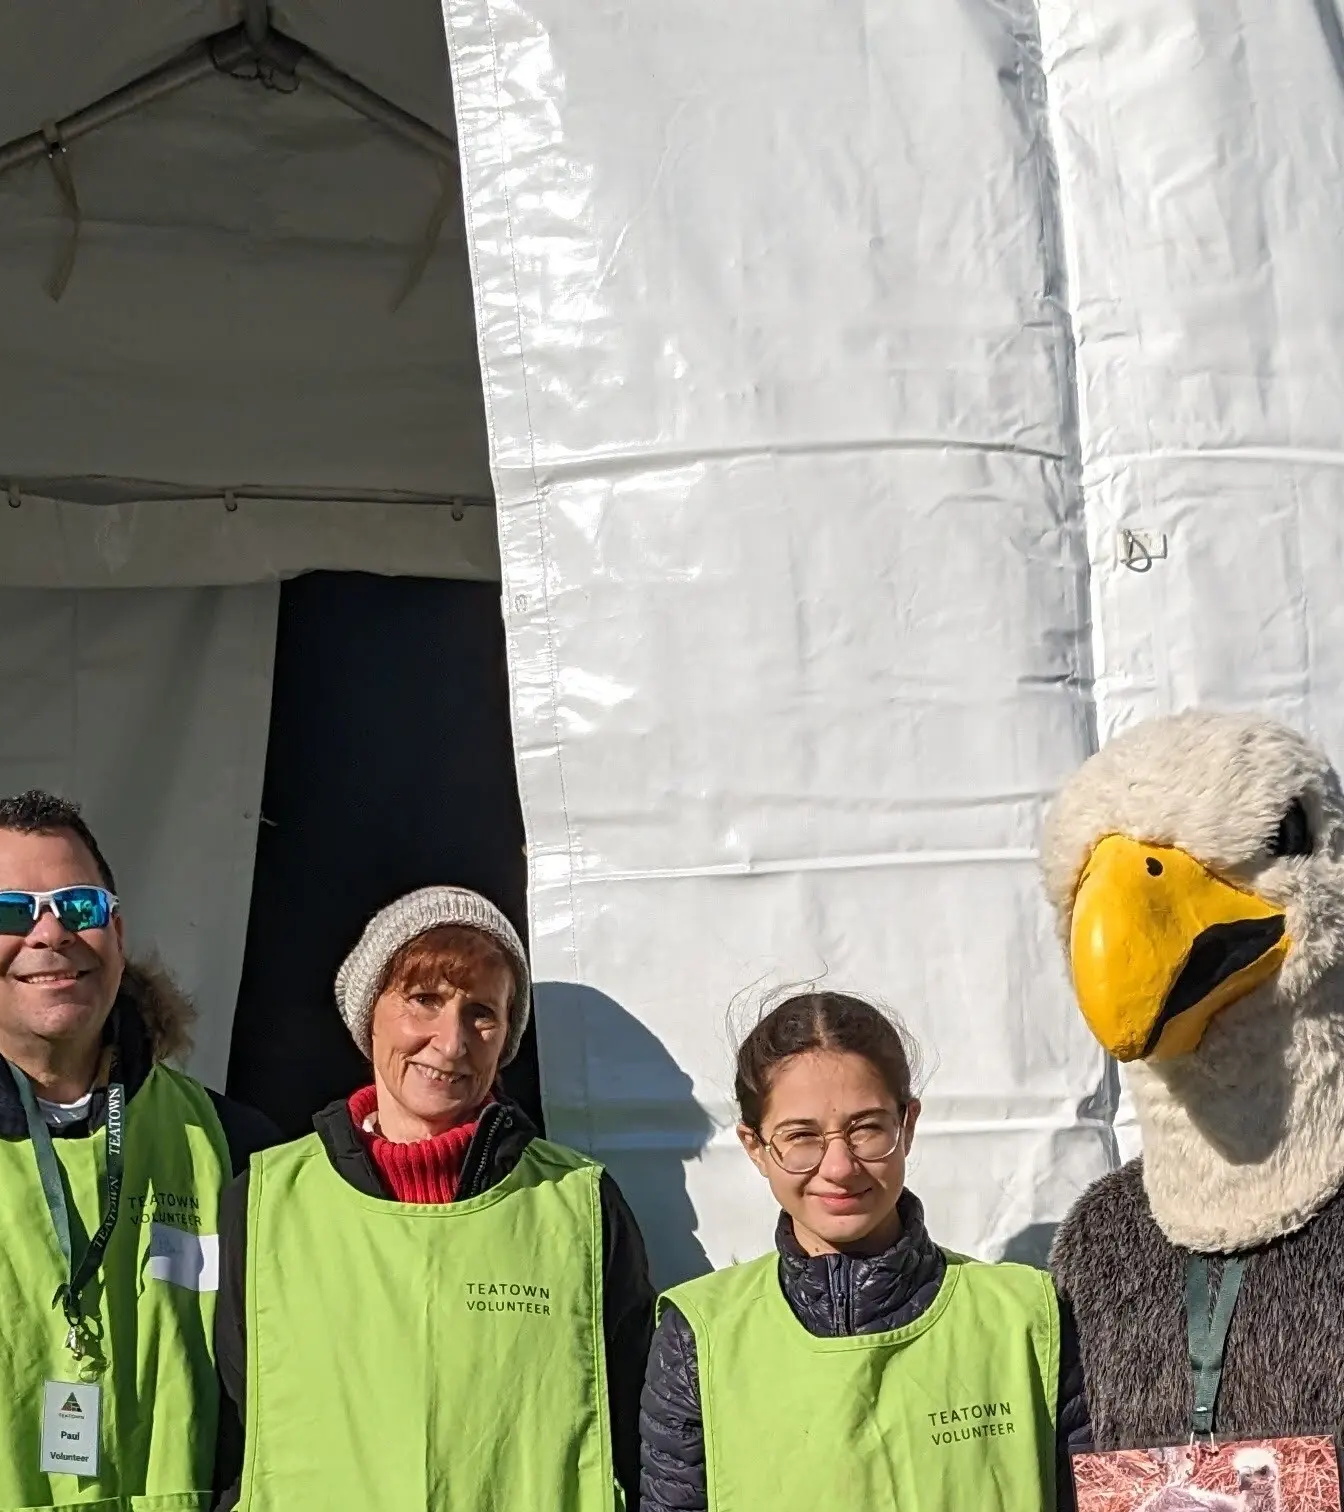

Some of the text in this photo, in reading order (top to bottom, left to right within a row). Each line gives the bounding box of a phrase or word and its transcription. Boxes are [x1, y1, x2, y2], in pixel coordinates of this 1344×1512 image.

[108, 1087, 121, 1156] TEATOWN
[128, 1193, 200, 1209] TEATOWN
[130, 1212, 202, 1227] VOLUNTEER
[466, 1283, 550, 1300] TEATOWN
[466, 1300, 551, 1316] VOLUNTEER
[927, 1402, 1011, 1427] TEATOWN
[60, 1430, 80, 1440] Paul
[931, 1422, 1016, 1446] VOLUNTEER
[50, 1451, 89, 1462] Volunteer
